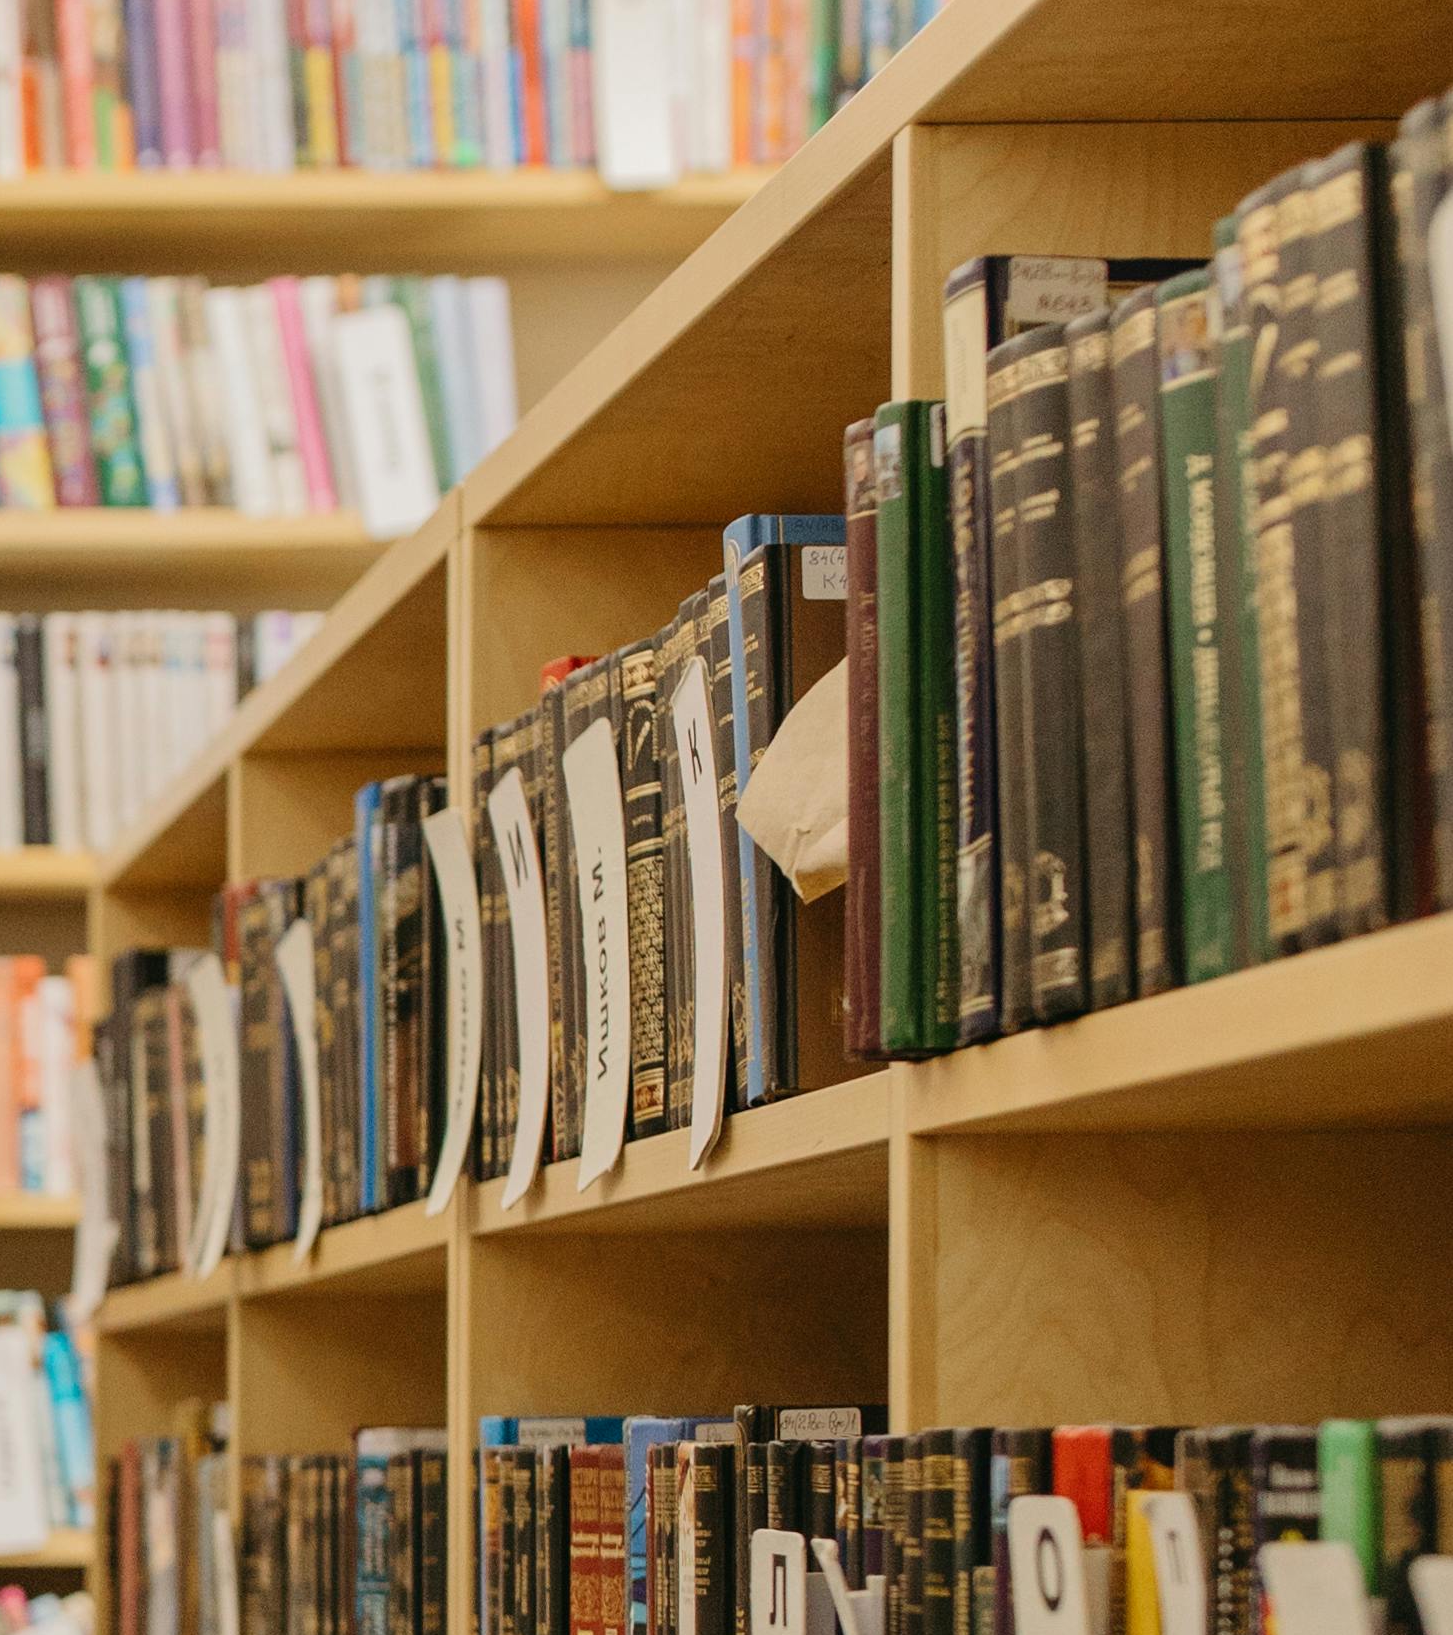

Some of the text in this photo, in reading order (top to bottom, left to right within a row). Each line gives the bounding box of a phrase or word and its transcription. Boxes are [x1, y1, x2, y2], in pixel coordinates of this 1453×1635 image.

[688, 717, 703, 786] К
[507, 821, 528, 889] И
[591, 845, 609, 1081] Ишков М.
[769, 1552, 788, 1626] Л
